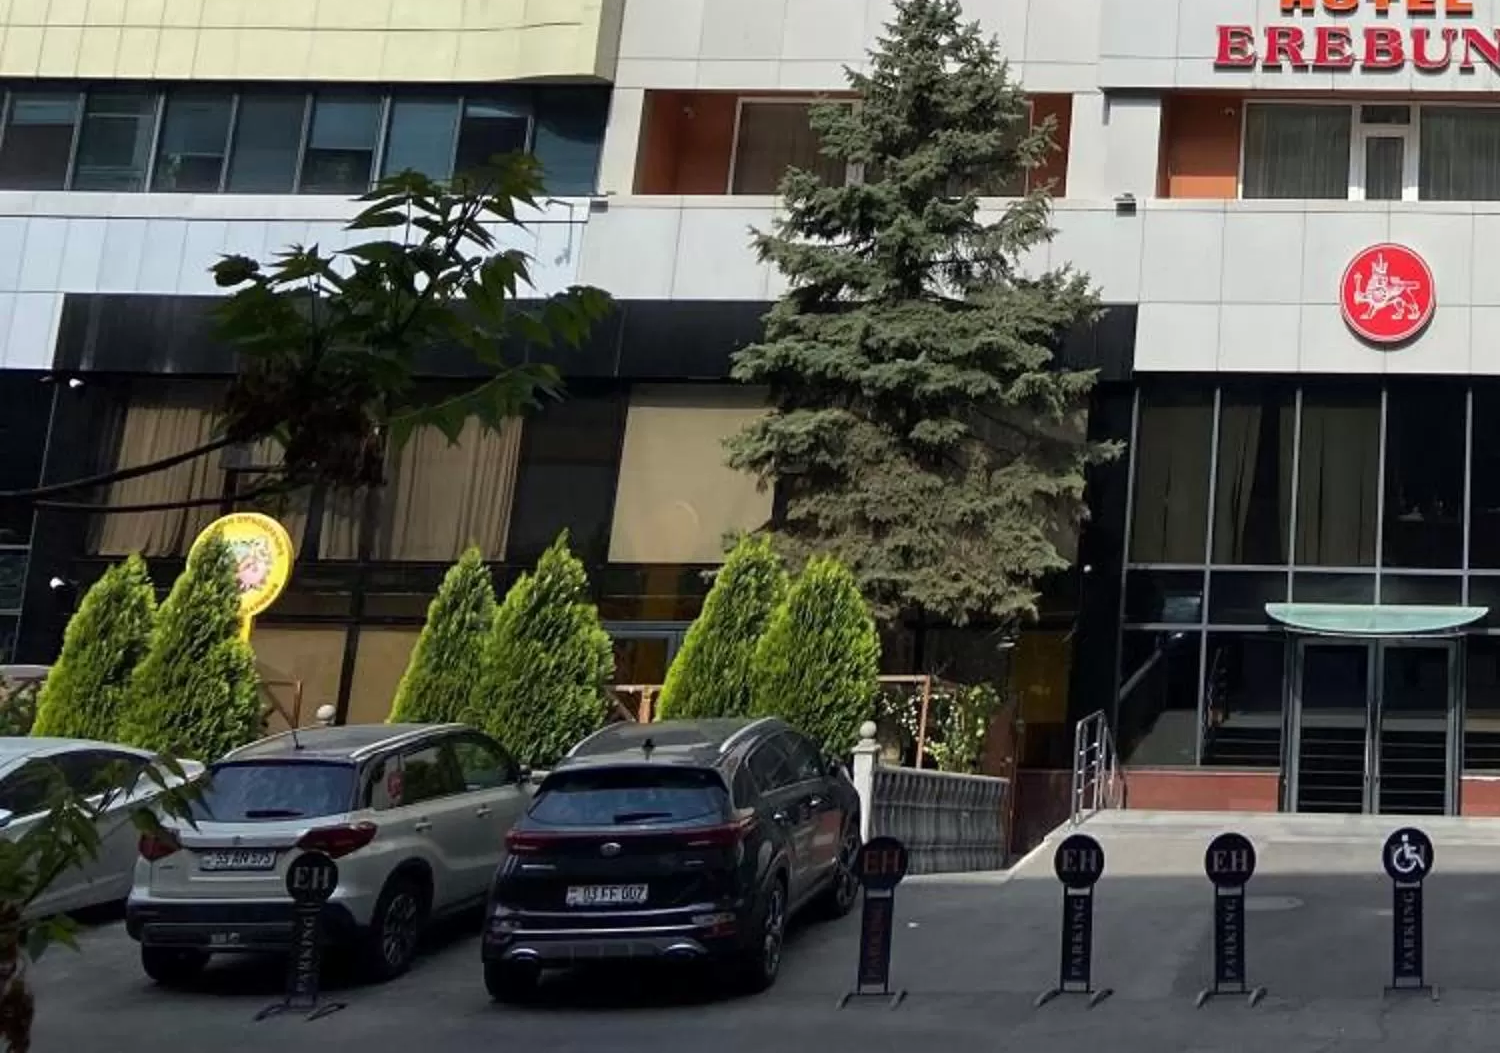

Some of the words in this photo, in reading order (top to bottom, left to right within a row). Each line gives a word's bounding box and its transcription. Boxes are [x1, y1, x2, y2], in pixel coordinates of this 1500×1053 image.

[864, 850, 900, 875] EH
[1062, 849, 1098, 872] EH
[1213, 849, 1249, 872] EH
[293, 867, 329, 889] EH
[1071, 898, 1086, 977] PARKING
[1224, 899, 1238, 979] PARKING
